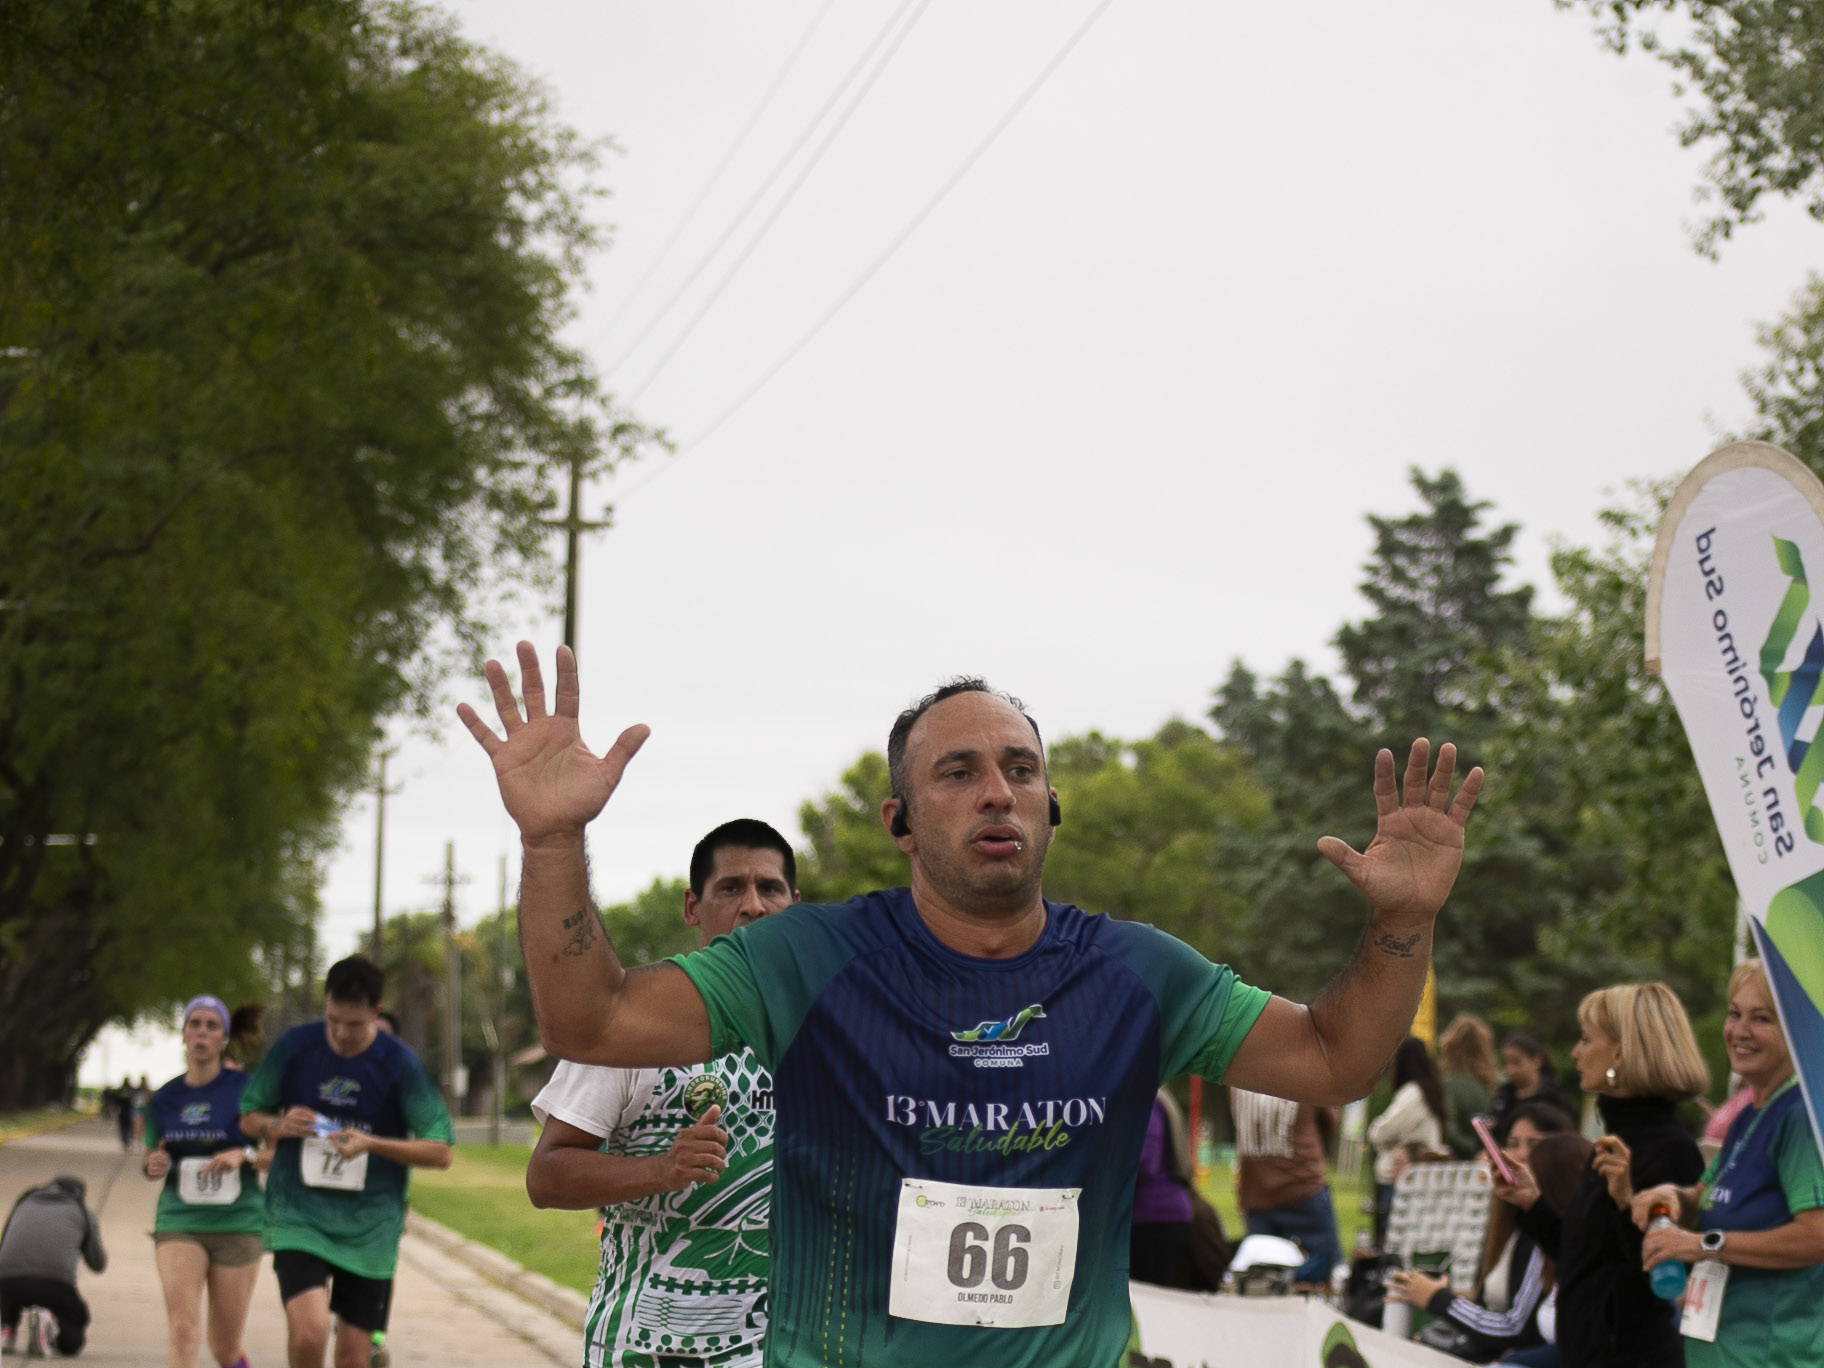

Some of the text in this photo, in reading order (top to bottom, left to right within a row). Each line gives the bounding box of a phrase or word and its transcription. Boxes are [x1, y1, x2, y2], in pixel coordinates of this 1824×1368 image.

[949, 1042, 1050, 1058] San Jerónimo Sud
[974, 1058, 1024, 1068] COMUNA
[925, 1097, 1107, 1131] MARATON
[919, 1118, 1072, 1157] Saludable
[947, 1222, 1032, 1290] 66
[957, 1291, 1014, 1305] OLMEDO PABLO
